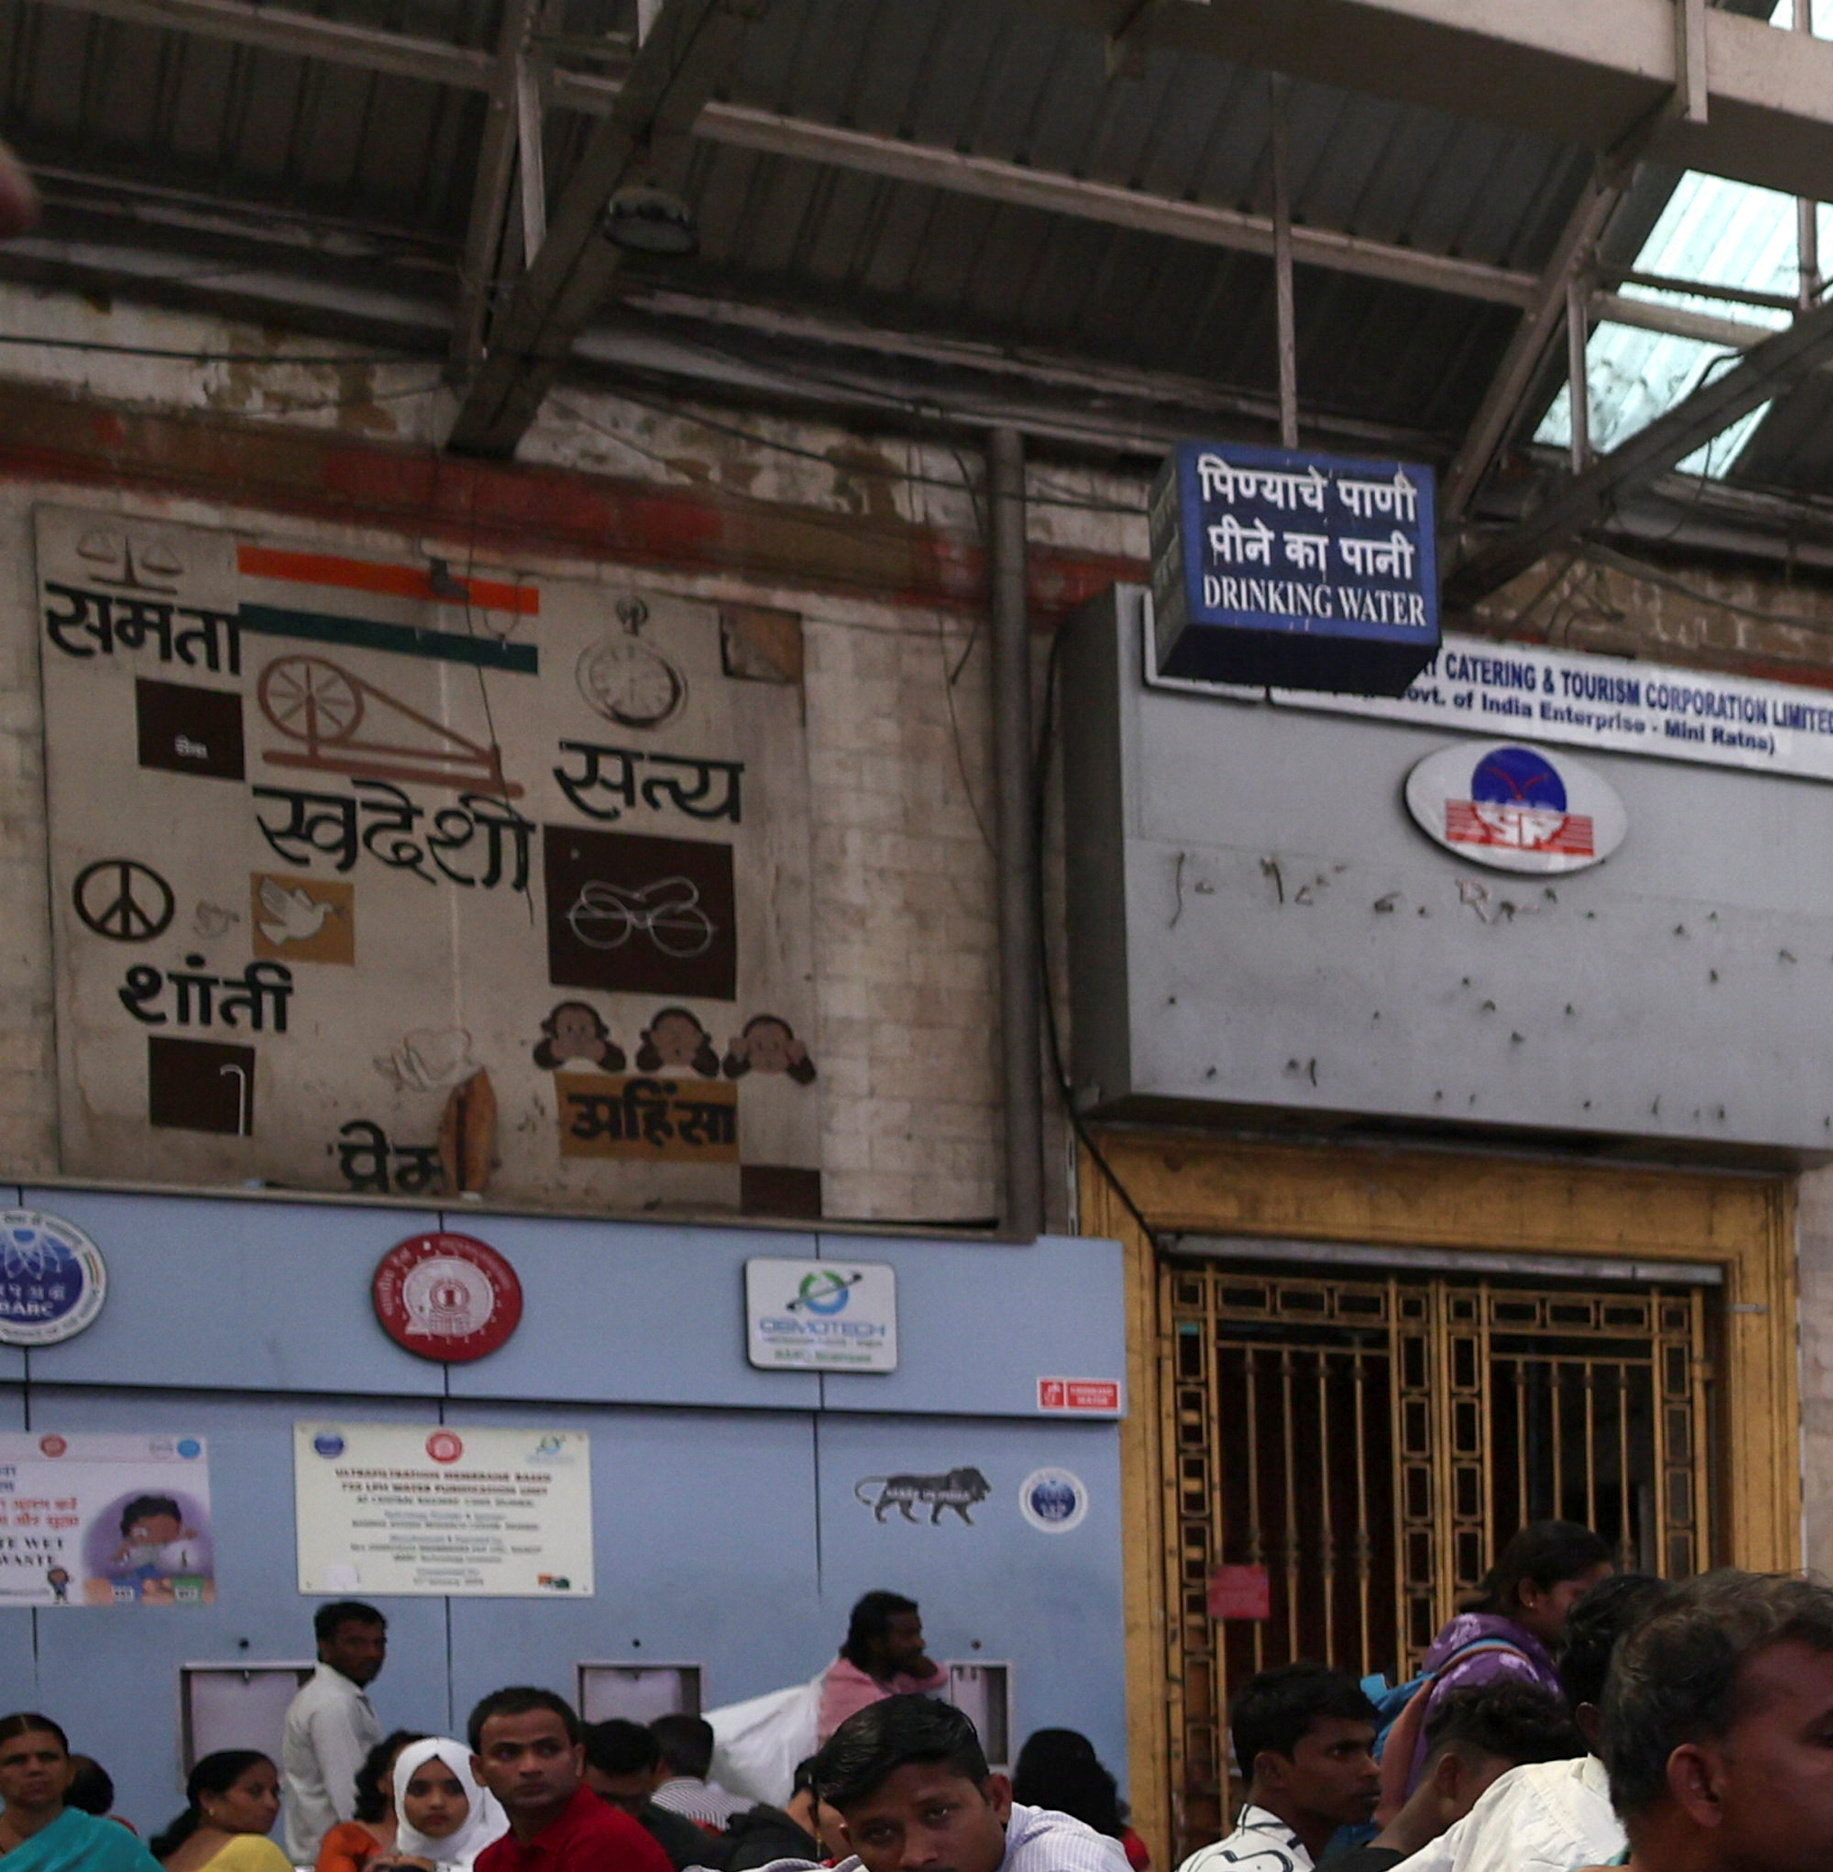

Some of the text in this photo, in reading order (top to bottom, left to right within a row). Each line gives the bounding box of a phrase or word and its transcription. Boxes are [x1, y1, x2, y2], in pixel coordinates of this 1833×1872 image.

[1198, 453, 1417, 522] पिण्याचे पाणी
[1208, 513, 1415, 580] पीने का पानी
[45, 580, 241, 676] समता
[1204, 574, 1427, 627] DRINKING WATER
[1446, 653, 1537, 692] CATERING
[1542, 666, 1555, 694] &
[1561, 669, 1641, 707] TOURISM
[1646, 683, 1768, 726] CORPORATION
[1454, 690, 1473, 709] of
[1482, 693, 1533, 717] India
[1540, 702, 1646, 733] Enterprise
[1665, 718, 1705, 743] Mini
[553, 740, 745, 822] सत्य
[118, 955, 292, 1032] शांती
[567, 1080, 737, 1149] अहिंसा
